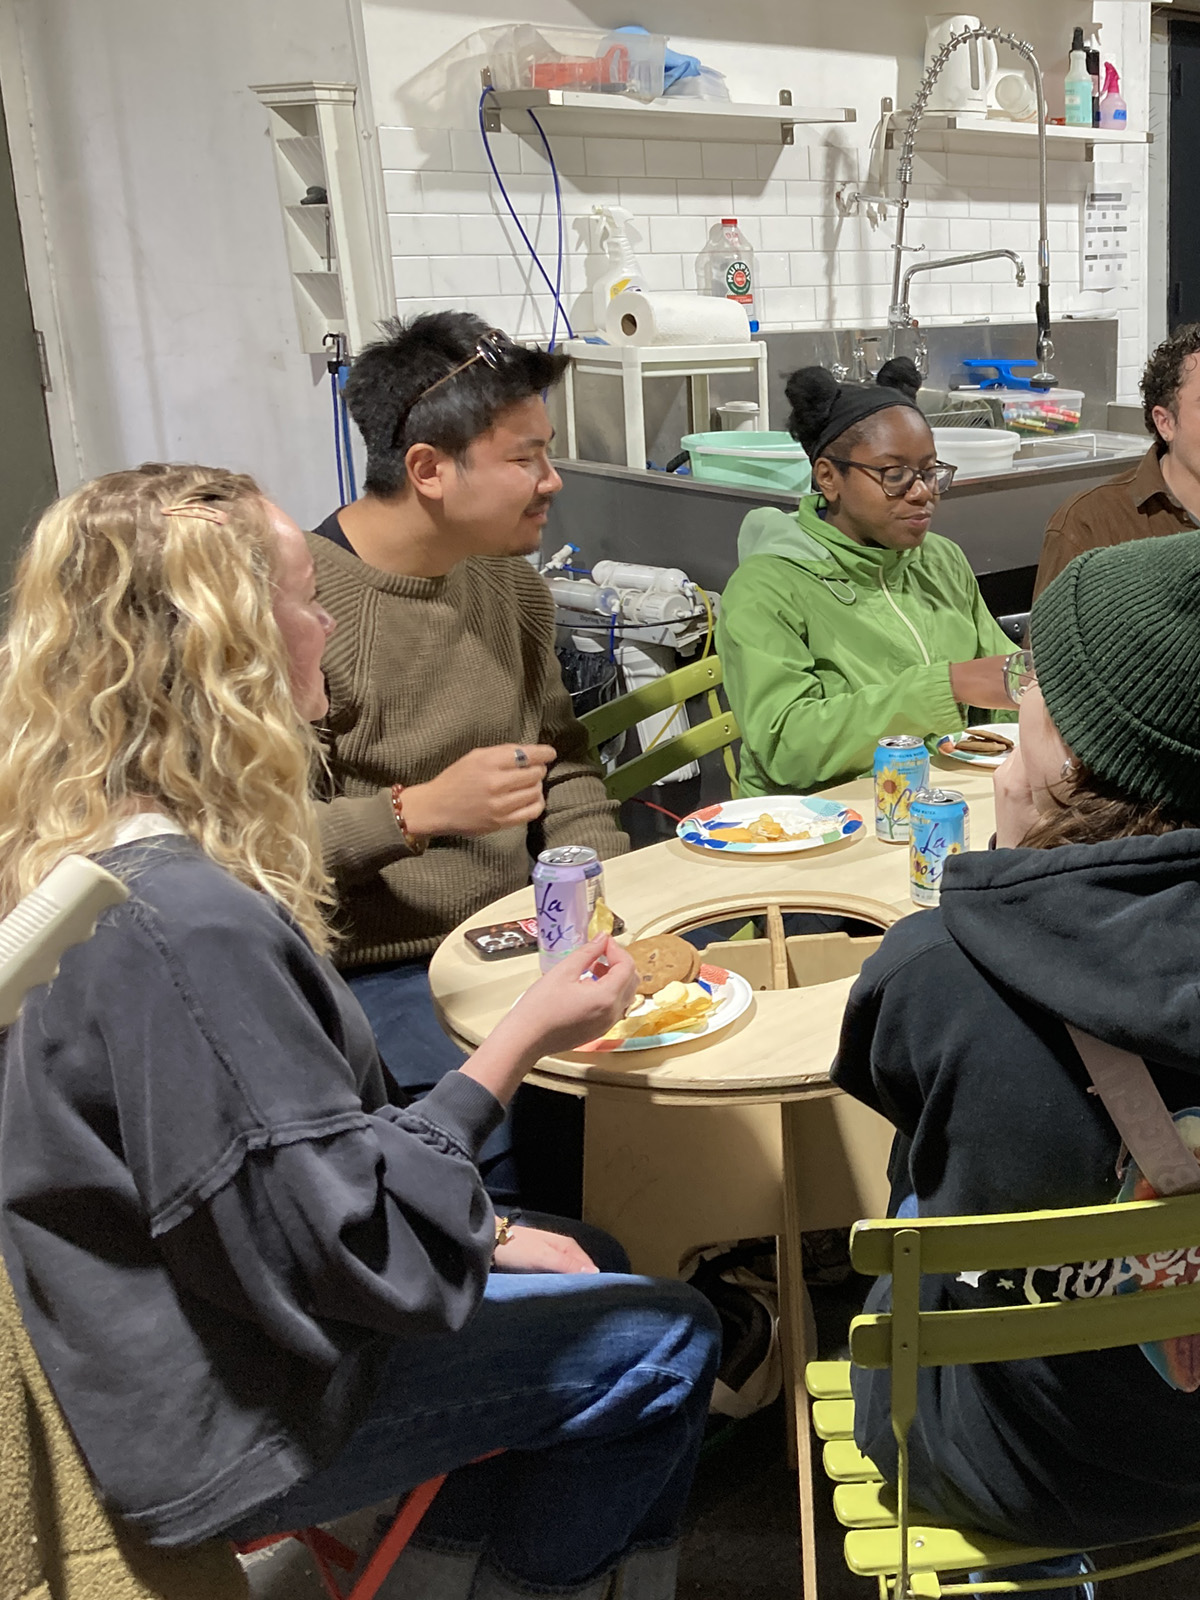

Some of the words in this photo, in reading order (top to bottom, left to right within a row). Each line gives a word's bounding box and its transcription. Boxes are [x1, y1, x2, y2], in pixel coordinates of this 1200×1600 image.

[727, 263, 751, 283] MURPHY
[920, 822, 947, 858] La
[537, 882, 565, 923] La
